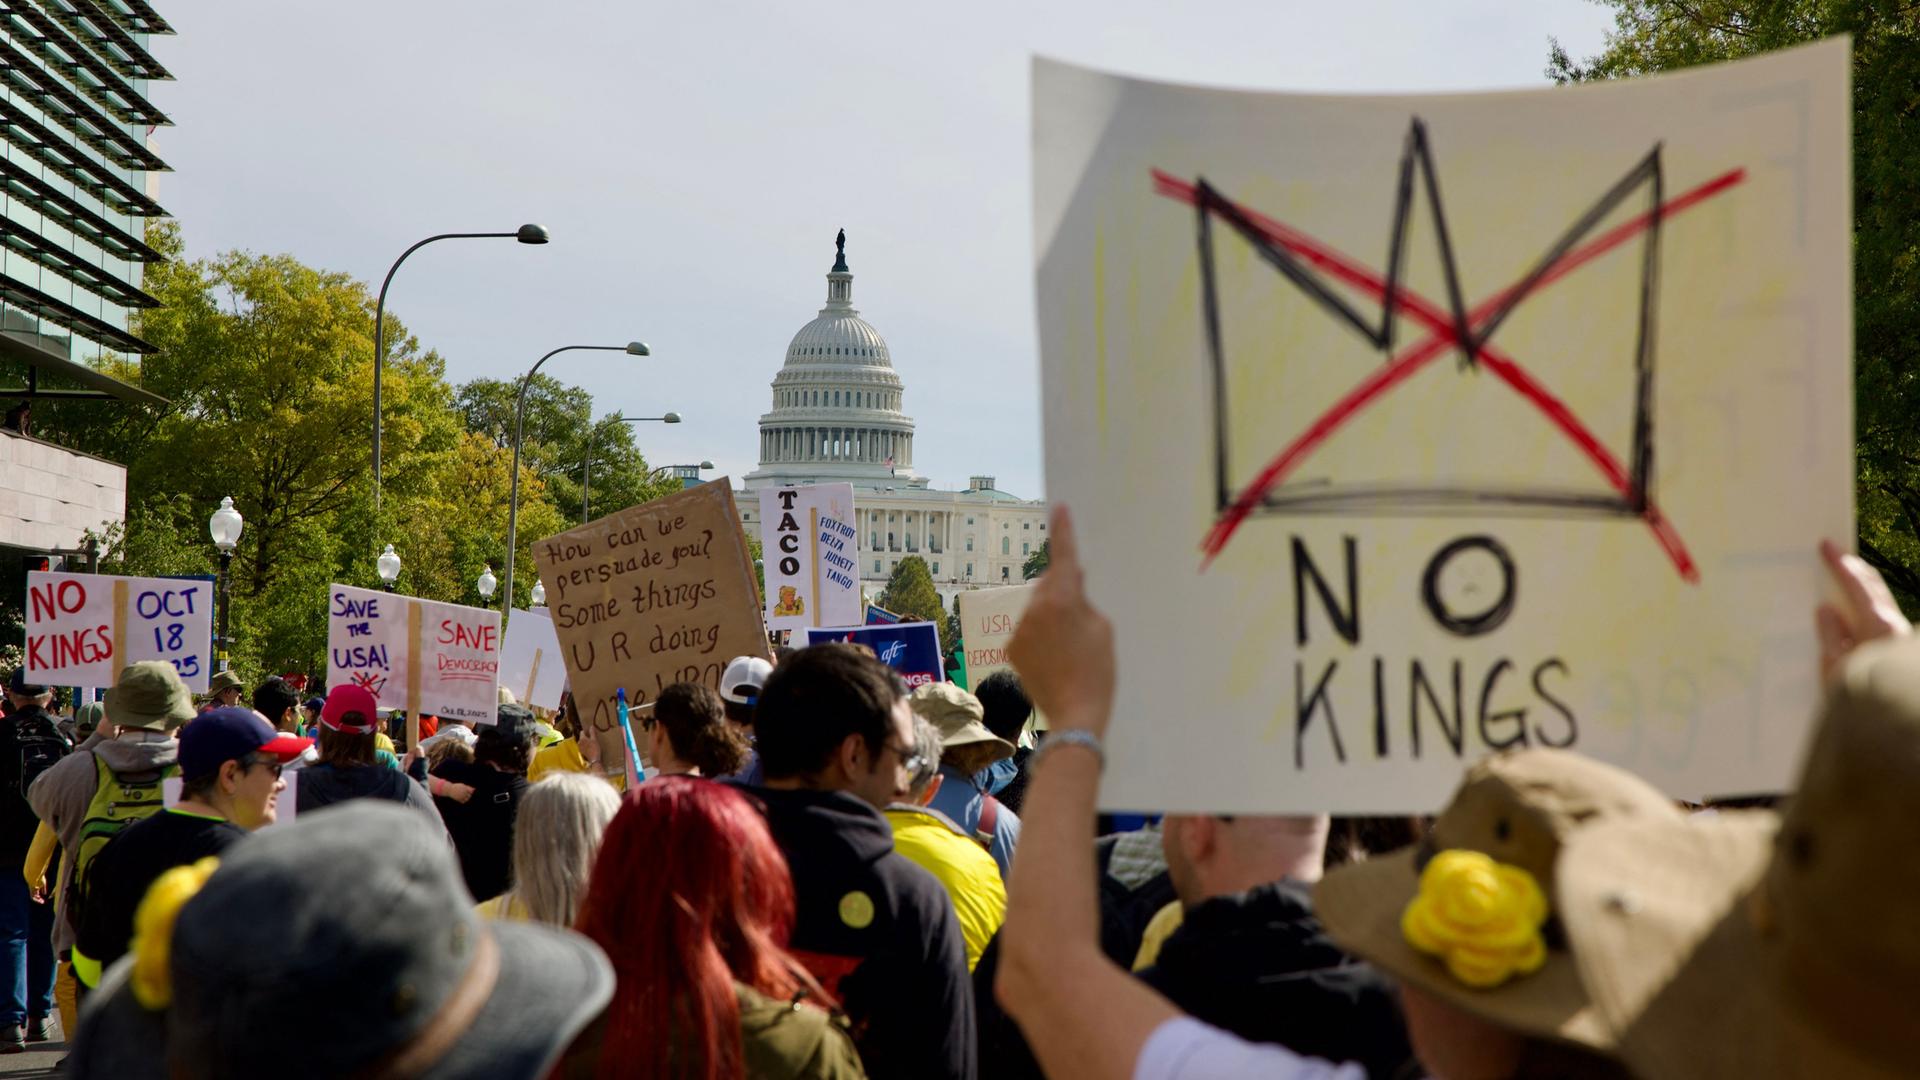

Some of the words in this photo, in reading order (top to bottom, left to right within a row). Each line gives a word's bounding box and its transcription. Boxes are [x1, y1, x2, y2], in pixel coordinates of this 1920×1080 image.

[547, 543, 592, 565] How
[607, 526, 647, 549] can
[658, 515, 688, 536] we
[777, 490, 800, 576] TACO
[819, 516, 856, 540] FOXTROT
[820, 532, 845, 552] DELTA
[556, 549, 664, 598] persuade
[665, 529, 713, 571] you?
[824, 550, 855, 572] JULIETT
[826, 567, 854, 590] TANGO
[1290, 534, 1518, 648] NO
[30, 580, 87, 623] NO
[137, 587, 198, 619] OCT
[332, 592, 380, 618] SAVE
[558, 597, 621, 629] Some
[632, 579, 716, 615] things
[154, 623, 185, 653] 18
[437, 620, 496, 651] SAVE
[981, 614, 1012, 634] USA
[28, 625, 113, 671] KINGS
[333, 644, 390, 671] USA!
[572, 641, 595, 672] U
[611, 632, 632, 662] R
[649, 624, 720, 654] doing
[881, 640, 907, 666] aft
[902, 674, 932, 687] NGS
[1295, 655, 1578, 770] KINGS
